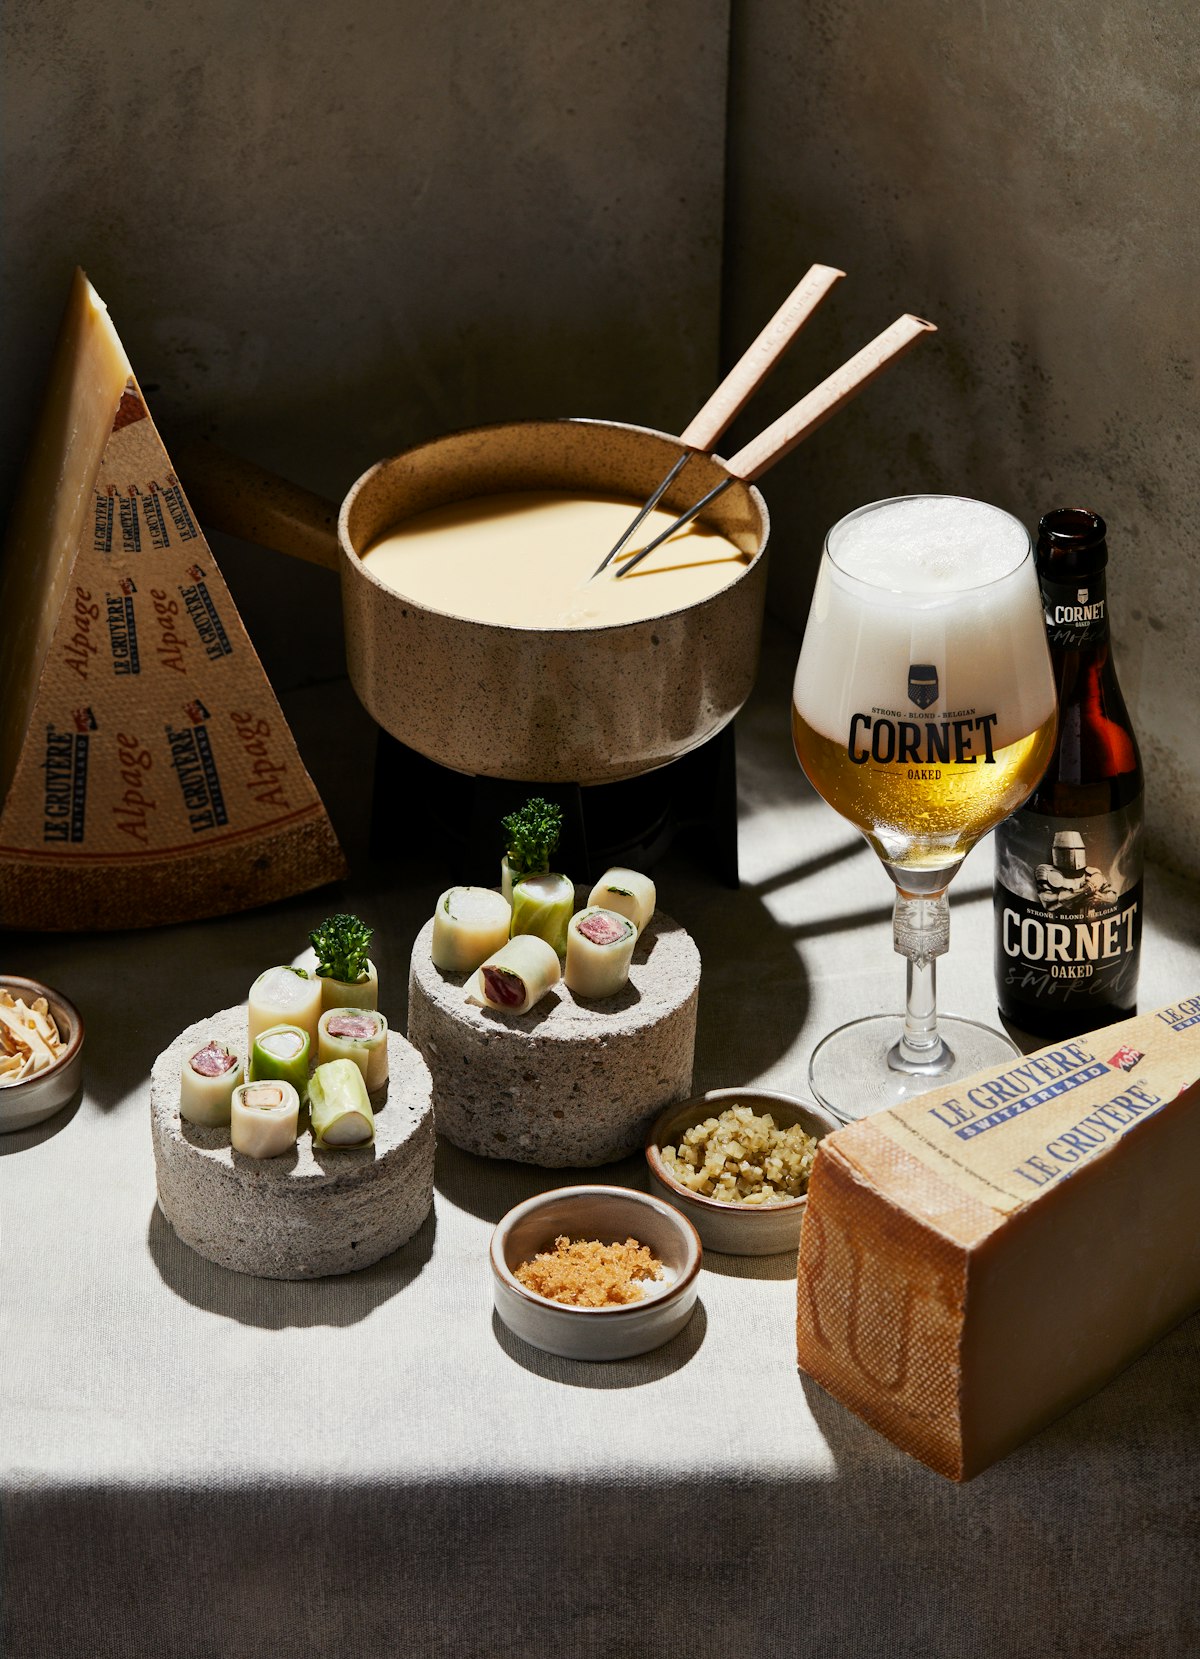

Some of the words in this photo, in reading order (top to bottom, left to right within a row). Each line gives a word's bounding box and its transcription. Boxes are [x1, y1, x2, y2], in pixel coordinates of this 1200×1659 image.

[64, 586, 99, 681] Alpage
[106, 596, 129, 659] GRUYÈRE
[150, 589, 188, 675] Alpage
[180, 584, 218, 647] GRUYÈRE
[1055, 600, 1104, 624] CORNET
[114, 660, 131, 676] LE
[205, 647, 225, 662] LE
[848, 713, 998, 765] CORNET
[871, 706, 902, 718] STRONG
[908, 712, 936, 720] BLOND
[942, 708, 976, 719] BELGIAN
[41, 732, 73, 818] GRUYÈRE
[112, 733, 157, 844] Alpage
[168, 727, 206, 811] GRUYÈRE
[230, 712, 290, 809] Alpage
[907, 768, 942, 781] OAKED
[44, 823, 70, 843] LE
[188, 808, 216, 833] LE
[1003, 902, 1138, 962] CORNET
[1026, 907, 1054, 919] STRONG
[1089, 905, 1118, 918] BELGIAN
[1050, 964, 1094, 979] OAKED
[1155, 1008, 1184, 1025] LE
[928, 1098, 977, 1129] LE
[967, 1042, 1096, 1111] GRUYÈRE
[962, 1067, 1102, 1137] SWITZERLAND
[1013, 1156, 1062, 1187] LE
[1046, 1085, 1162, 1165] GRUYÈRE
